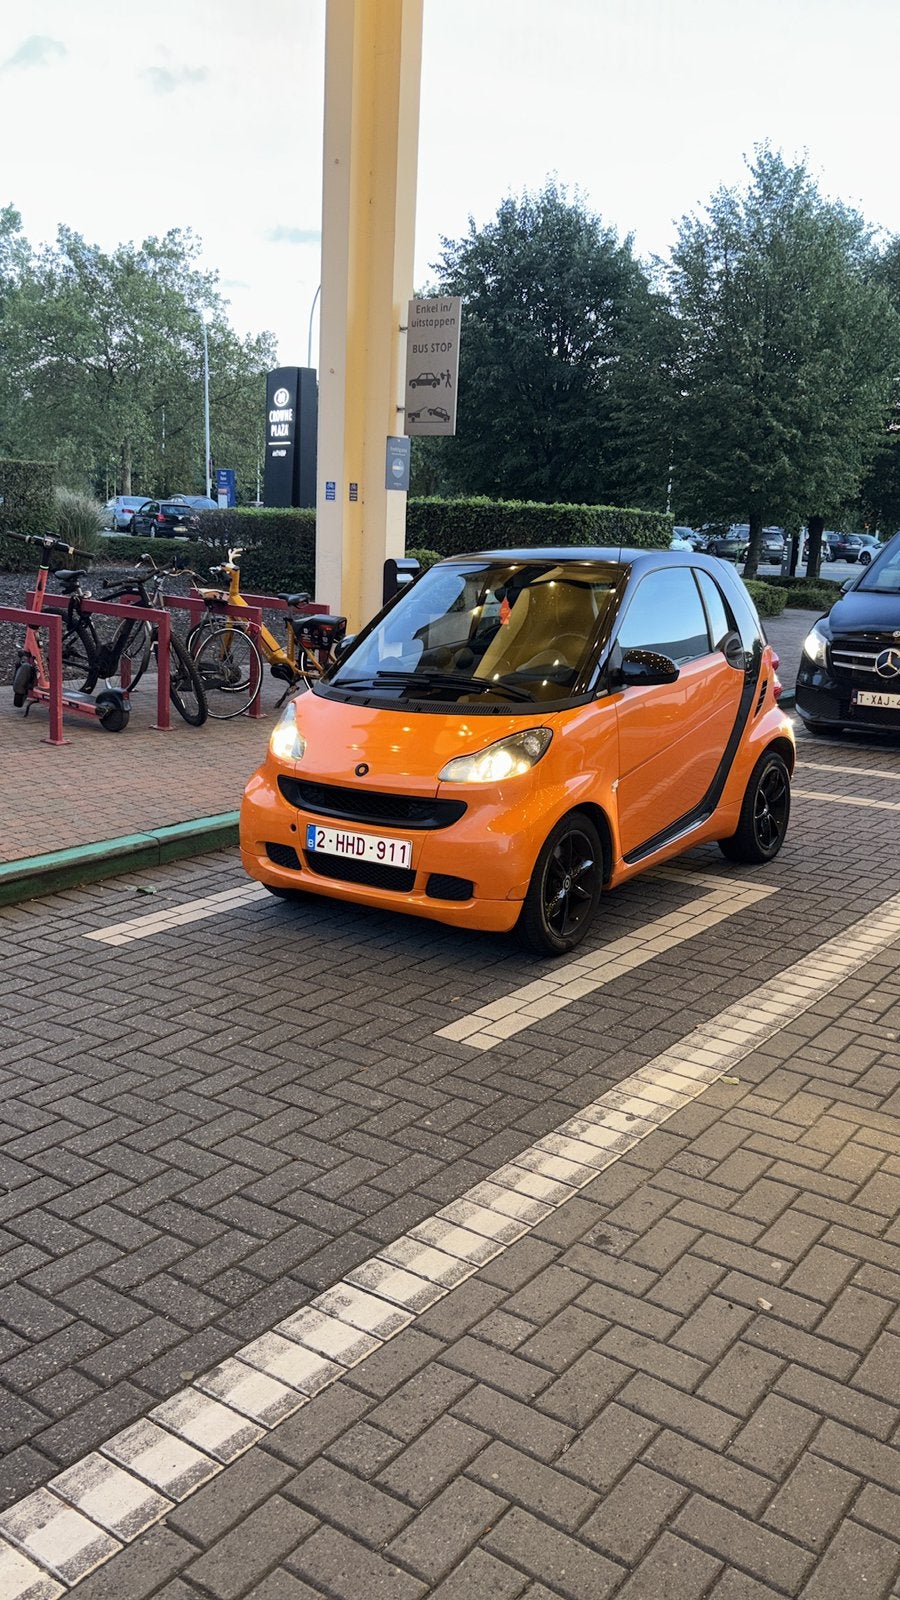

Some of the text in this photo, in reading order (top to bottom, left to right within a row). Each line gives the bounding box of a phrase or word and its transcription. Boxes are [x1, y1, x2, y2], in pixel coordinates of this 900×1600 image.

[416, 303, 439, 314] Enkel
[411, 318, 456, 329] uitstoppen
[412, 342, 453, 354] BUS STOP
[269, 408, 293, 423] CROWNE
[270, 424, 289, 437] PLAZA
[316, 830, 407, 864] 2-HHD-911
